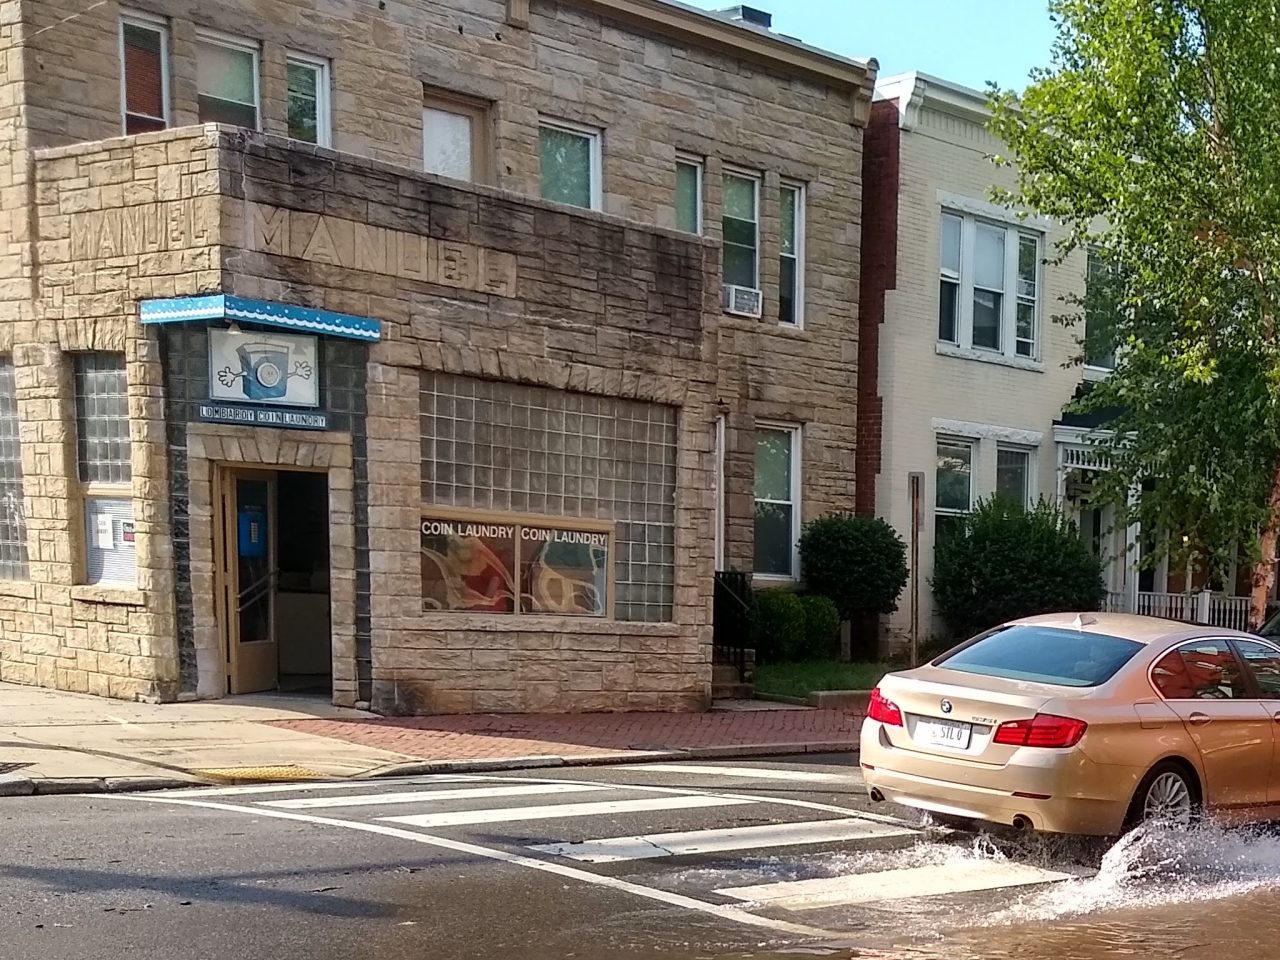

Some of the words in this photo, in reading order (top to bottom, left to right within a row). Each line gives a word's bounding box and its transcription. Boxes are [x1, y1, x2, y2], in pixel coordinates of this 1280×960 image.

[70, 201, 208, 257] MANUEL
[248, 201, 516, 296] MANUEL
[200, 406, 254, 421] LOMBARDY
[258, 411, 281, 423] COIN
[283, 414, 326, 427] LAUNDRY
[421, 522, 453, 535] COIN
[457, 524, 514, 538] LAUNDRY
[521, 527, 550, 541] COIN
[554, 532, 606, 545] LAUNDRY
